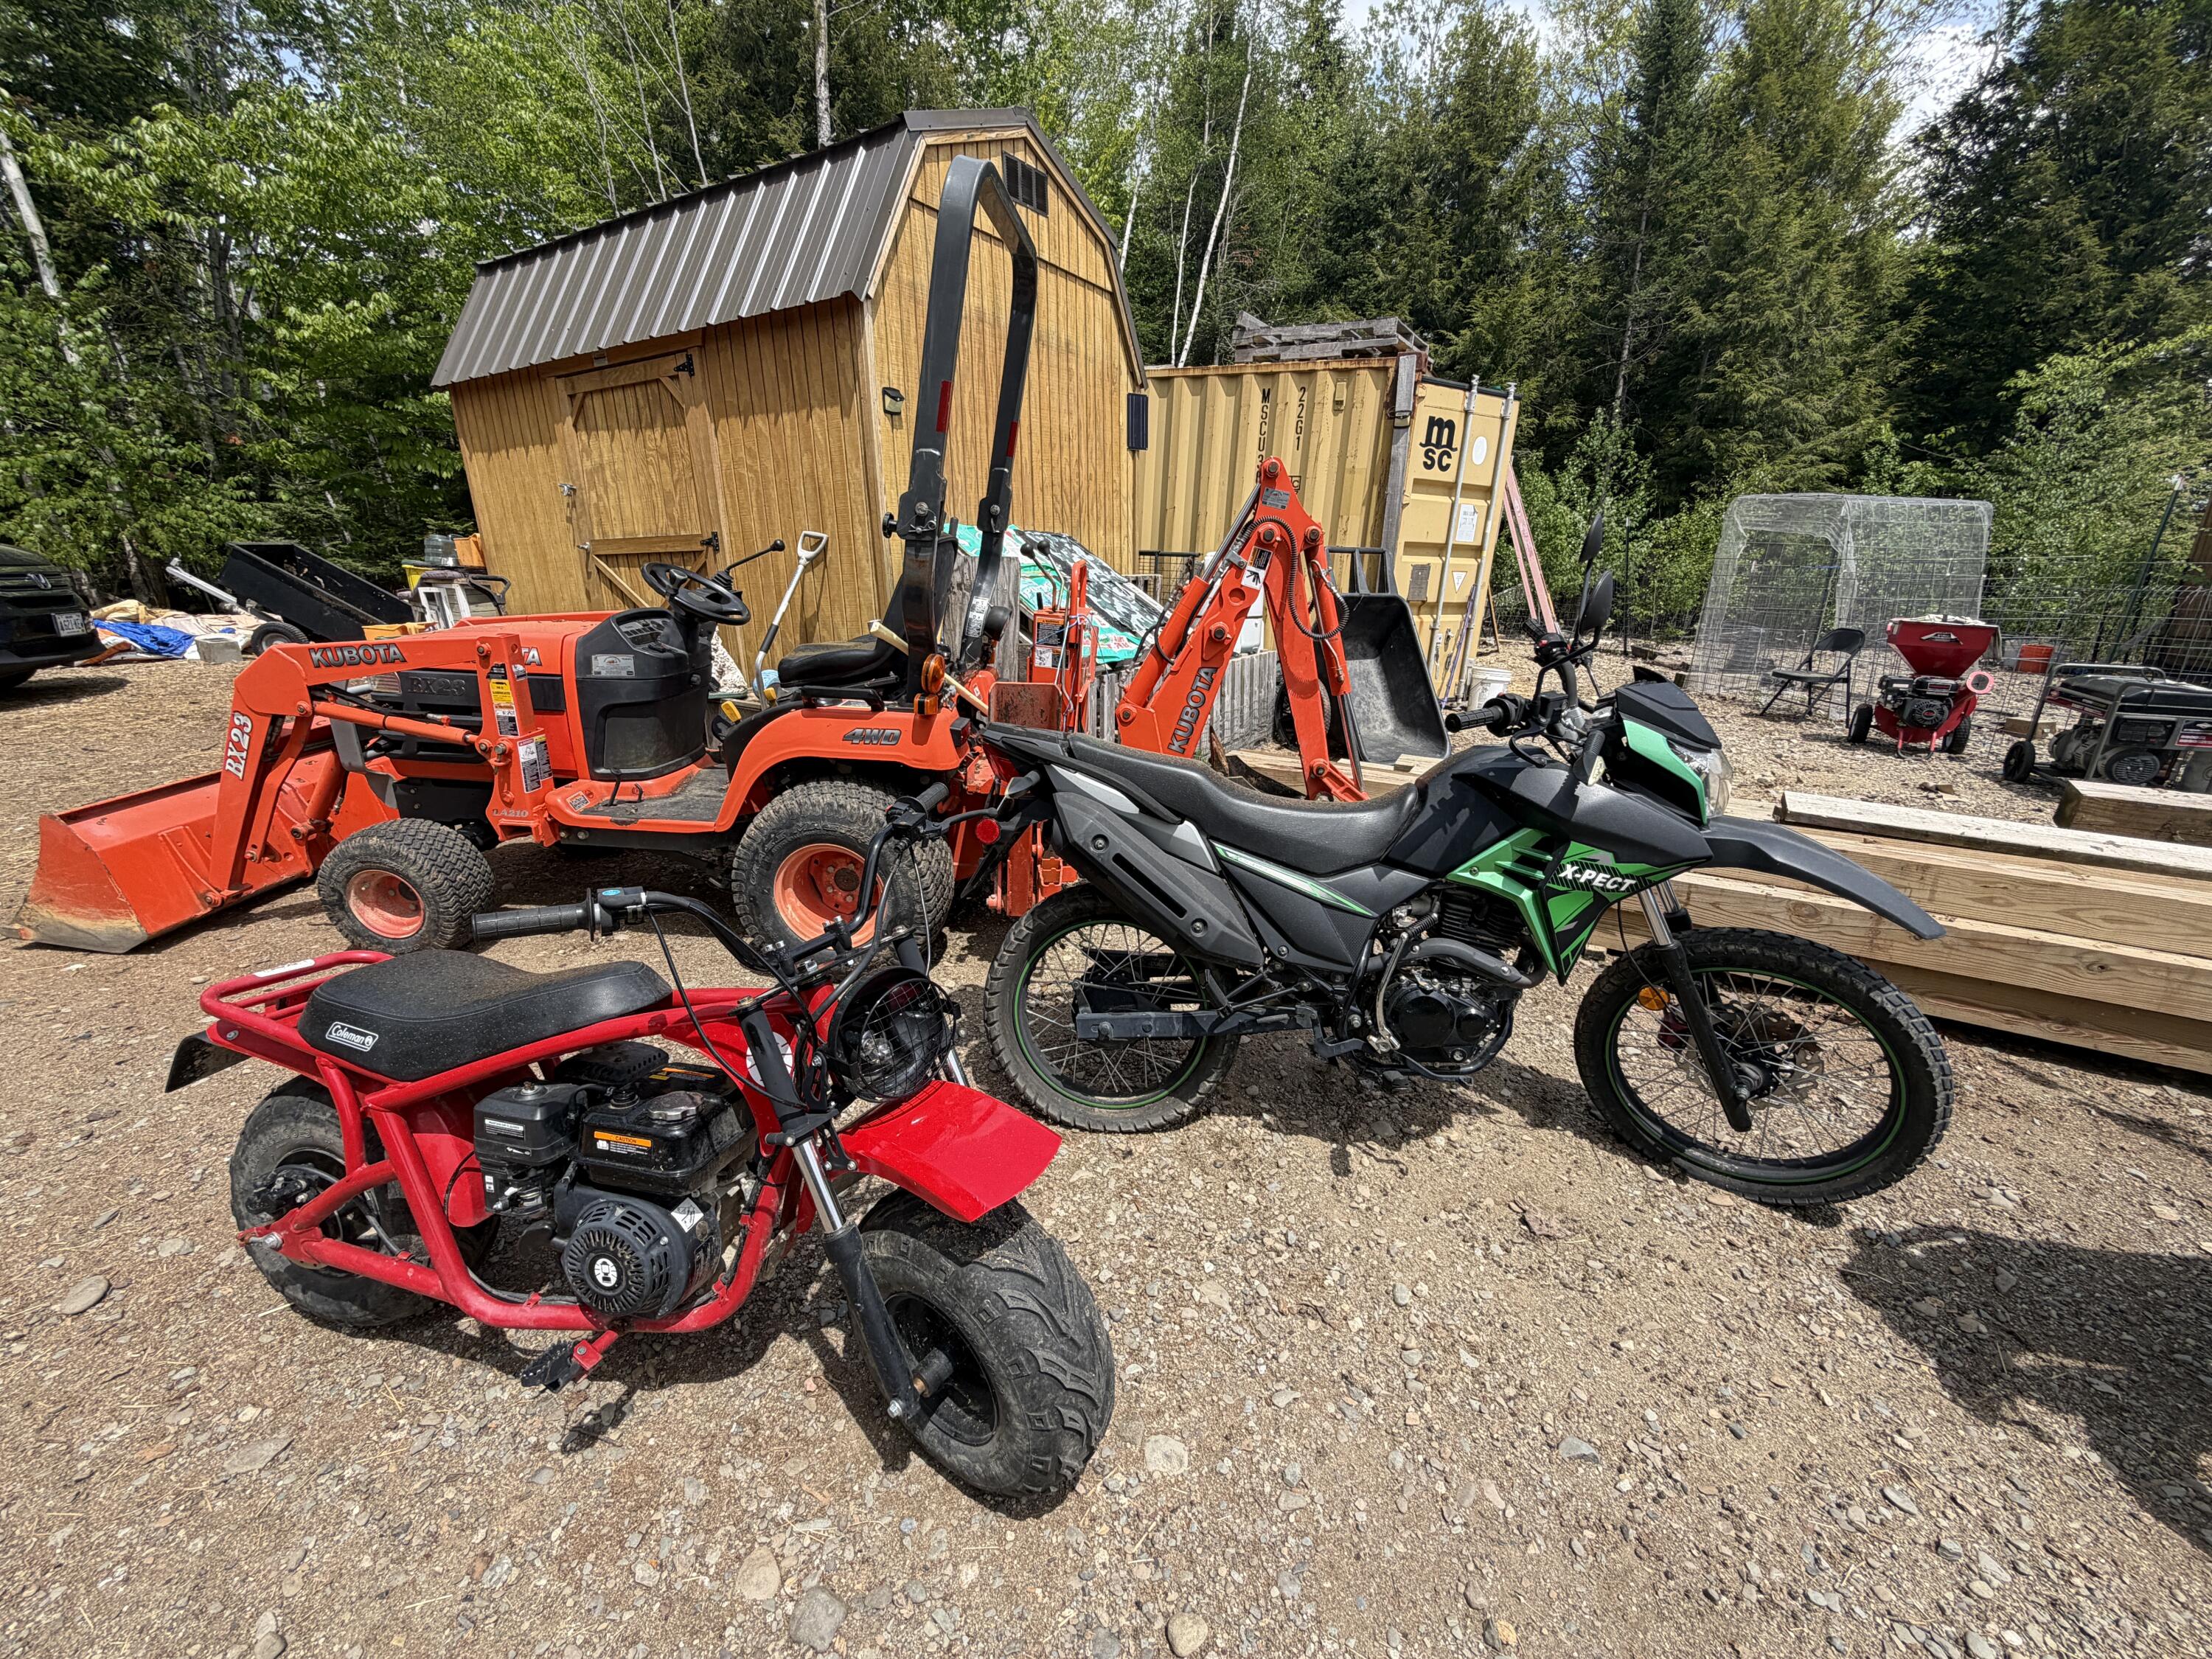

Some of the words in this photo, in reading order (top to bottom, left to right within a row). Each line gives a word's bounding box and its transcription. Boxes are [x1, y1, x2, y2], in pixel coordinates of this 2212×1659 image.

[308, 643, 407, 668] KUBOTA
[407, 676, 466, 696] BX23
[1168, 667, 1218, 754] KUBOTA
[224, 711, 253, 781] BX23
[842, 727, 902, 746] 4WD
[492, 809, 529, 818] LA210
[1558, 863, 1636, 891] X-PECT
[332, 1025, 365, 1044] Coleman
